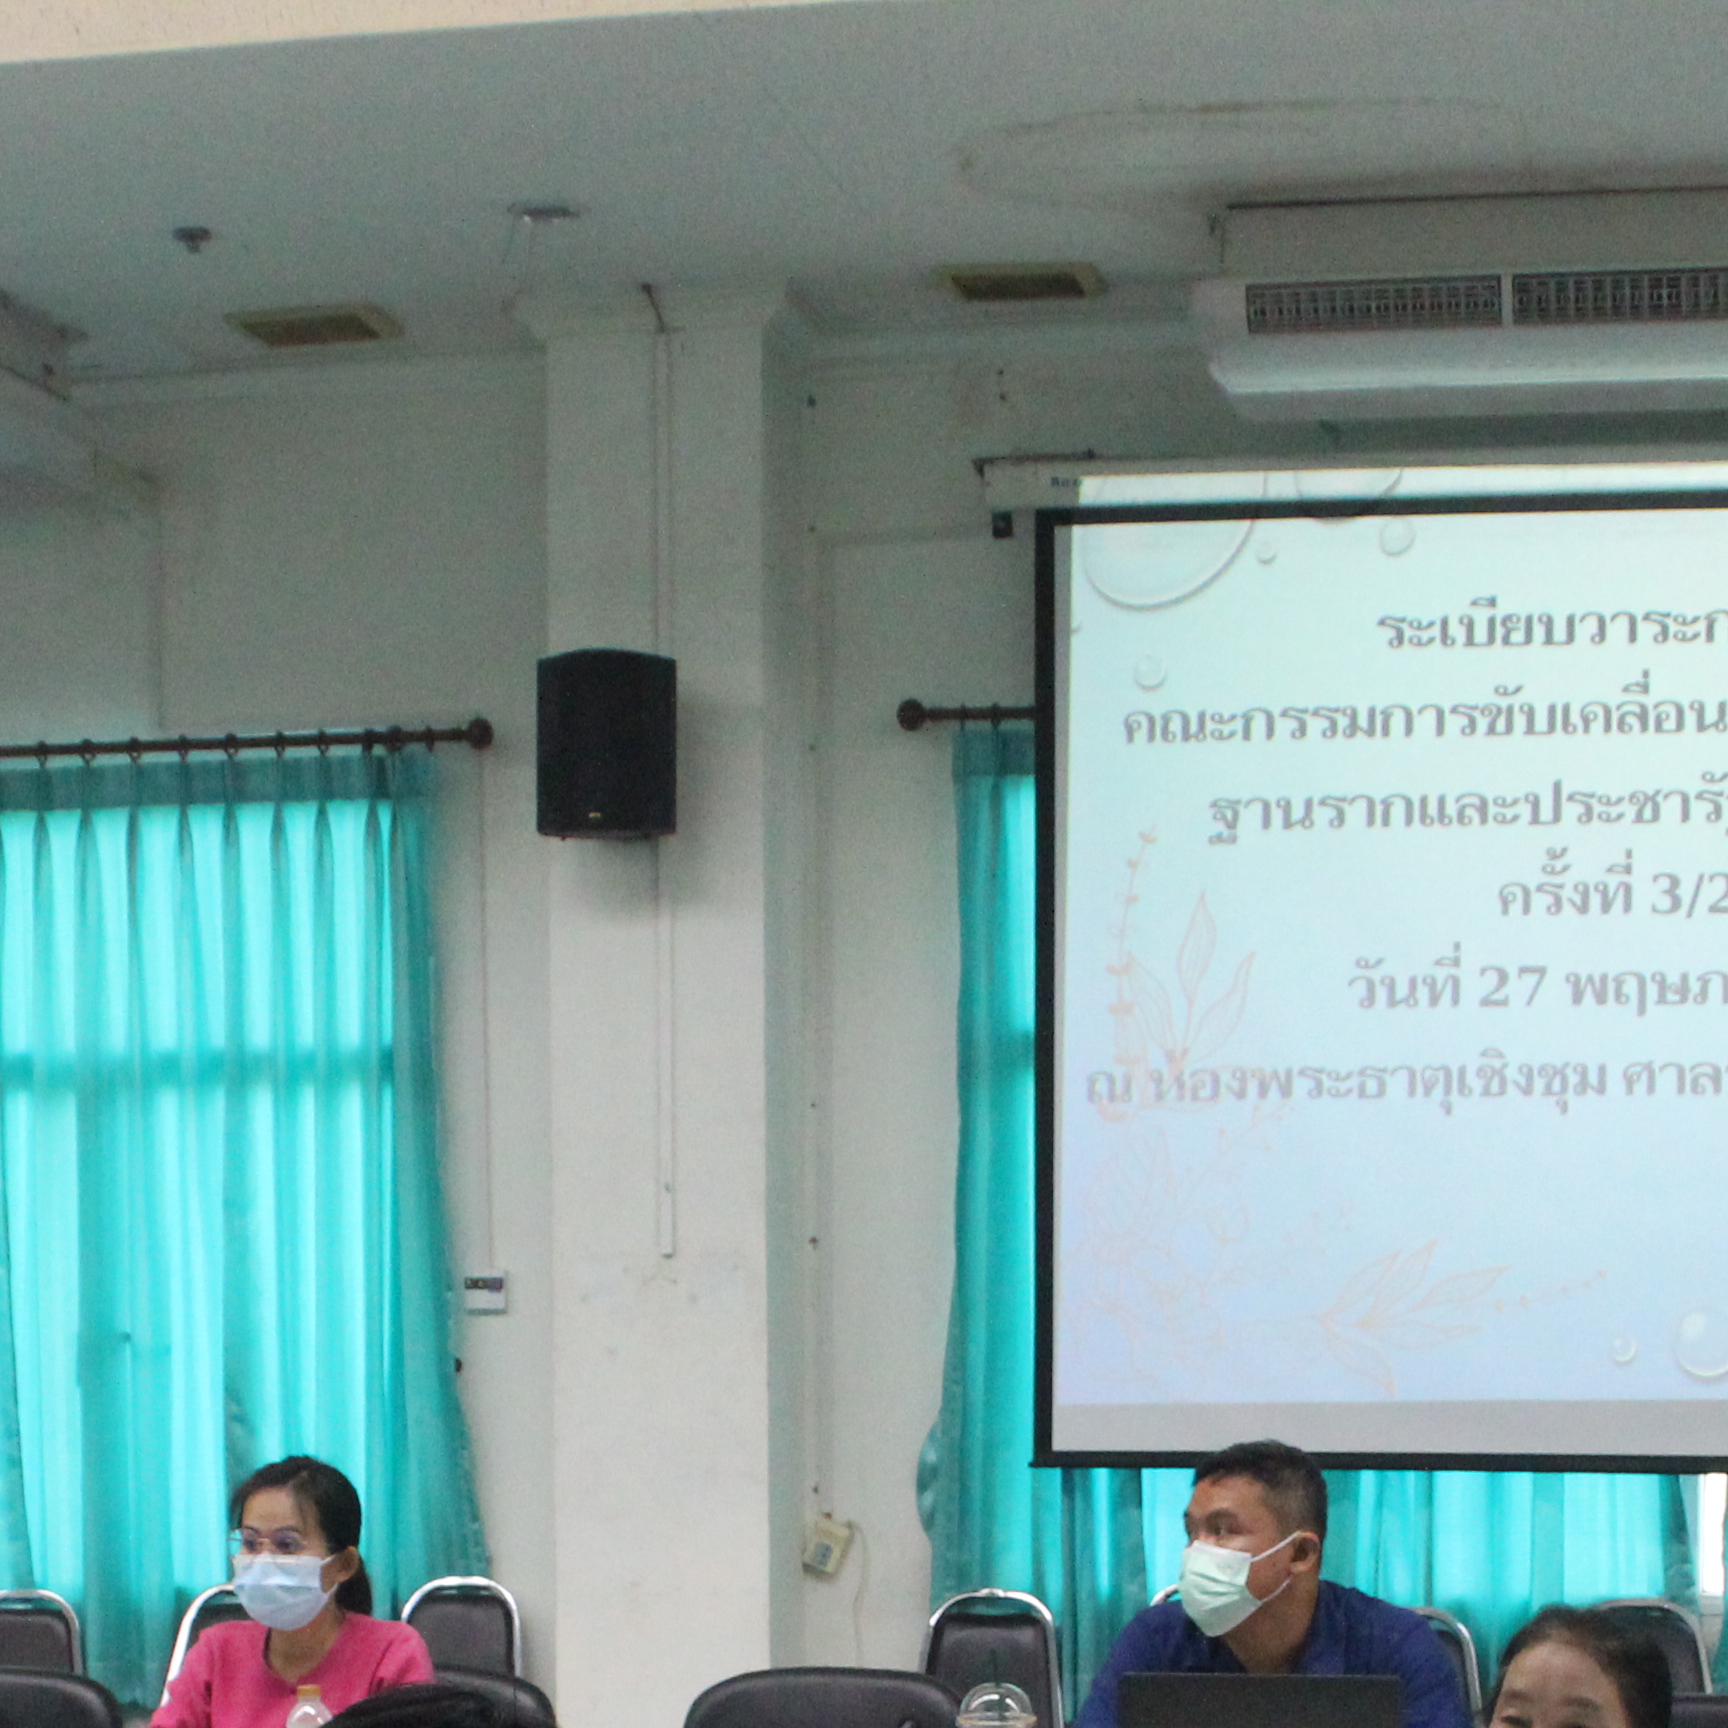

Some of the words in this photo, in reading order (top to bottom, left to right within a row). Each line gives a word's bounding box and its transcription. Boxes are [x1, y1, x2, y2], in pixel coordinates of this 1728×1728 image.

[1498, 847, 1633, 916] ครั้งที่
[1348, 942, 1462, 1009] วันที่
[1479, 965, 1548, 1008] 27
[1086, 1069, 1134, 1103] ณ
[1148, 1047, 1608, 1116] ห้องพระธาตุเชิงชุม
